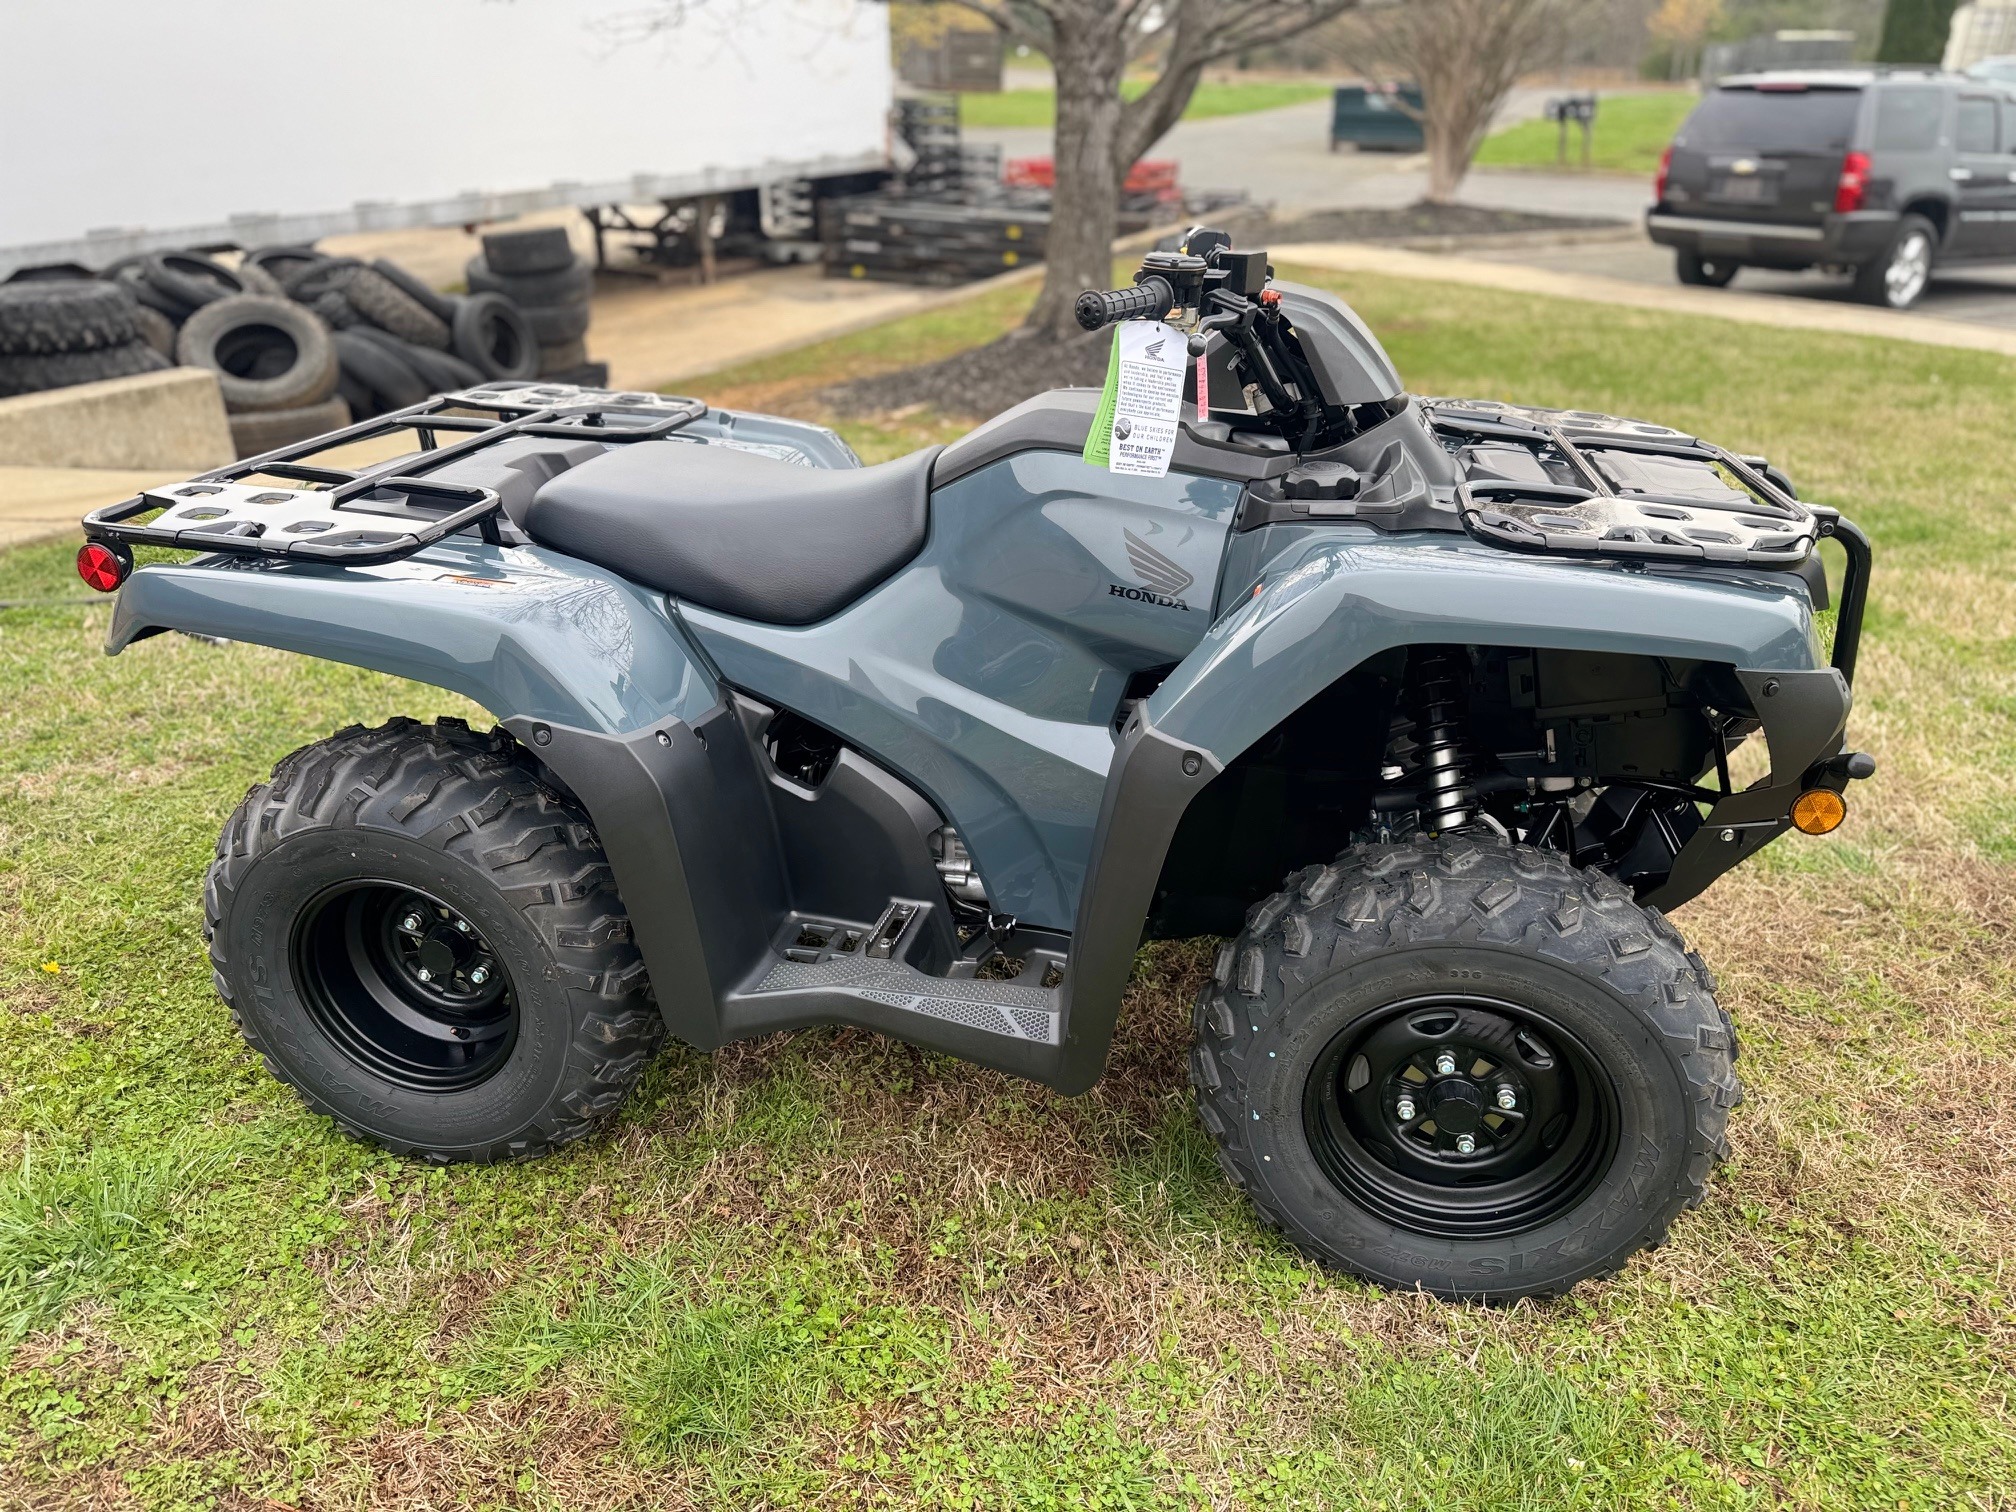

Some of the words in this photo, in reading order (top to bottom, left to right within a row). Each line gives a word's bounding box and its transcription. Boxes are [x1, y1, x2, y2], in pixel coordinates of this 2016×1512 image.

[1147, 434, 1173, 443] CHILDREN
[1108, 584, 1190, 611] HONDA
[248, 953, 402, 1118] MAXXIS
[1467, 1134, 1660, 1276] MAXXIS
[1374, 1245, 1452, 1272] M977
